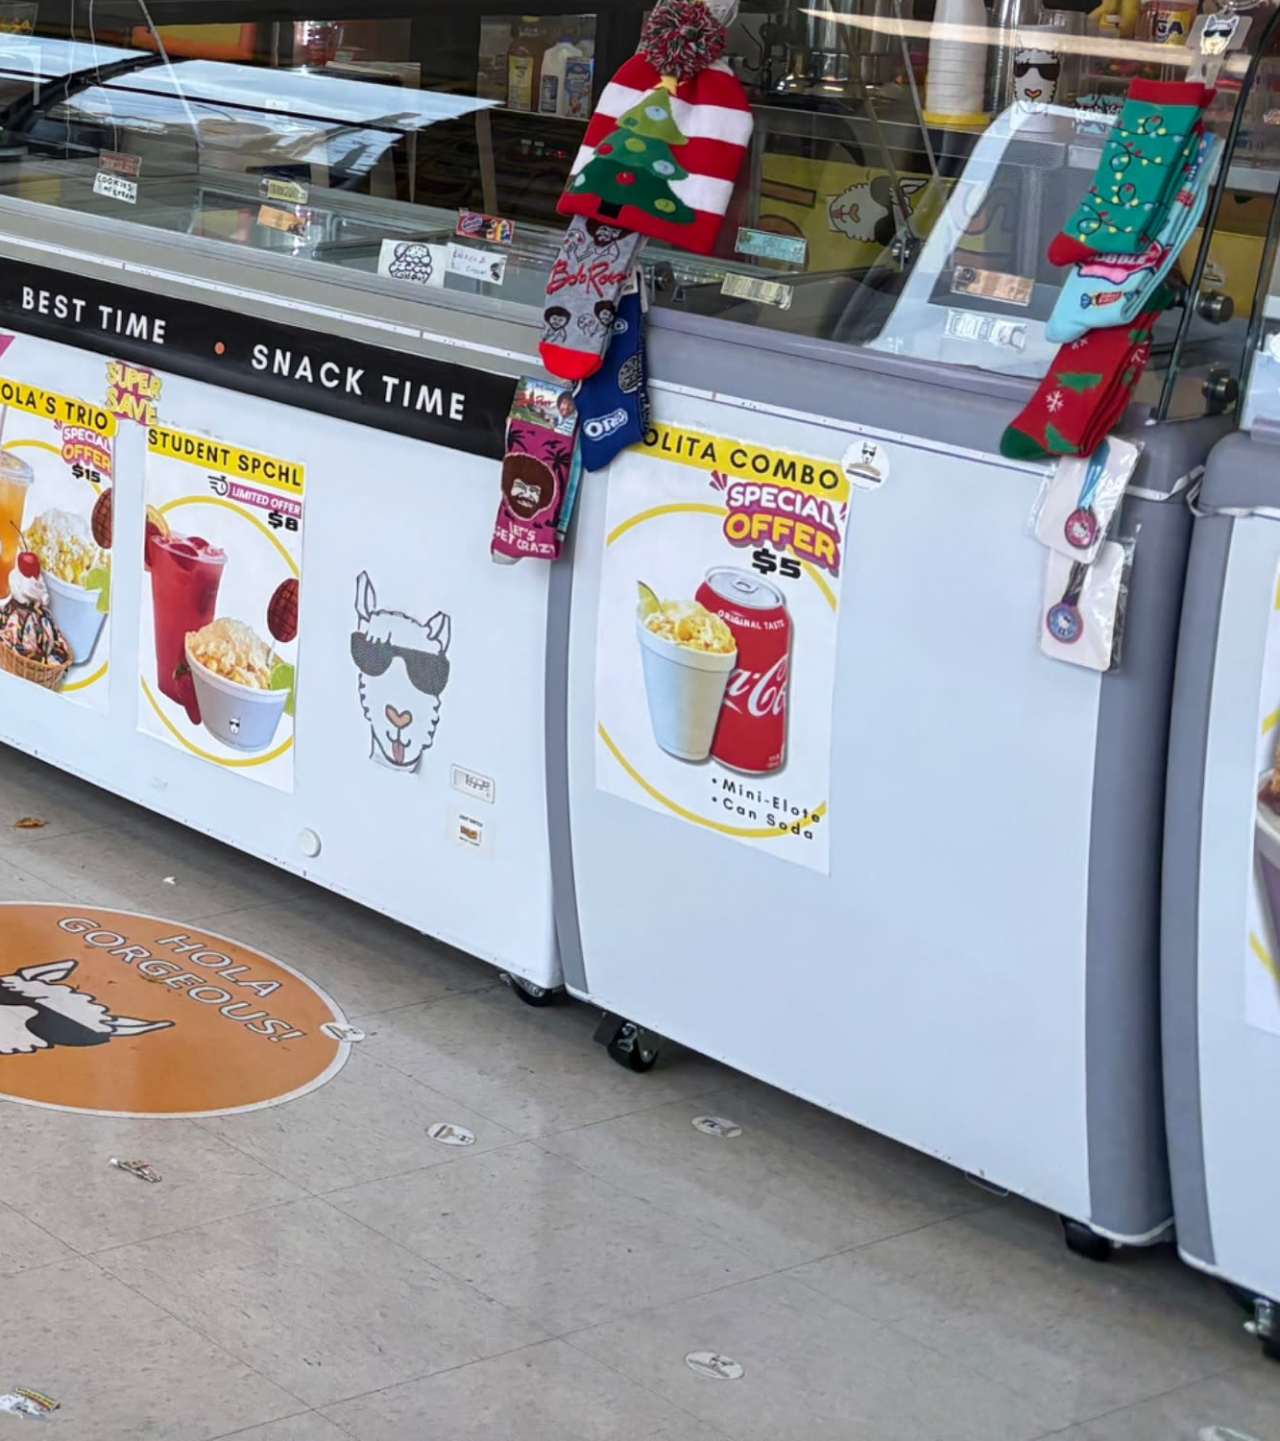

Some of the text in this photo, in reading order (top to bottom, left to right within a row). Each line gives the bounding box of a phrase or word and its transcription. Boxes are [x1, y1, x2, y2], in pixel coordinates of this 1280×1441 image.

[545, 260, 586, 295] Bob
[20, 286, 86, 322] BEST
[96, 306, 167, 345] TIME
[250, 343, 365, 396] SNACK
[380, 374, 466, 422] TIME
[106, 361, 163, 400] SUPER
[64, 401, 109, 431] TRIO
[106, 387, 159, 426] SAVE
[61, 443, 113, 472] OFFER
[62, 425, 113, 453] SPECIAL
[147, 427, 303, 488] STUDENT SPCHL
[71, 463, 101, 484] $15
[729, 448, 840, 490] COMBO
[231, 485, 301, 516] LIMITED OFFER
[727, 481, 838, 529] SPECIAL
[267, 510, 300, 532] $8
[508, 519, 536, 541] LET'S
[725, 512, 838, 566] OFFER
[751, 548, 802, 580] $5
[716, 608, 762, 631] ORIGINAL
[721, 777, 821, 825] Mini-Elote
[722, 797, 815, 841] Can Soda
[57, 916, 310, 1046] GORGEOUS!
[154, 931, 284, 999] HOLA
